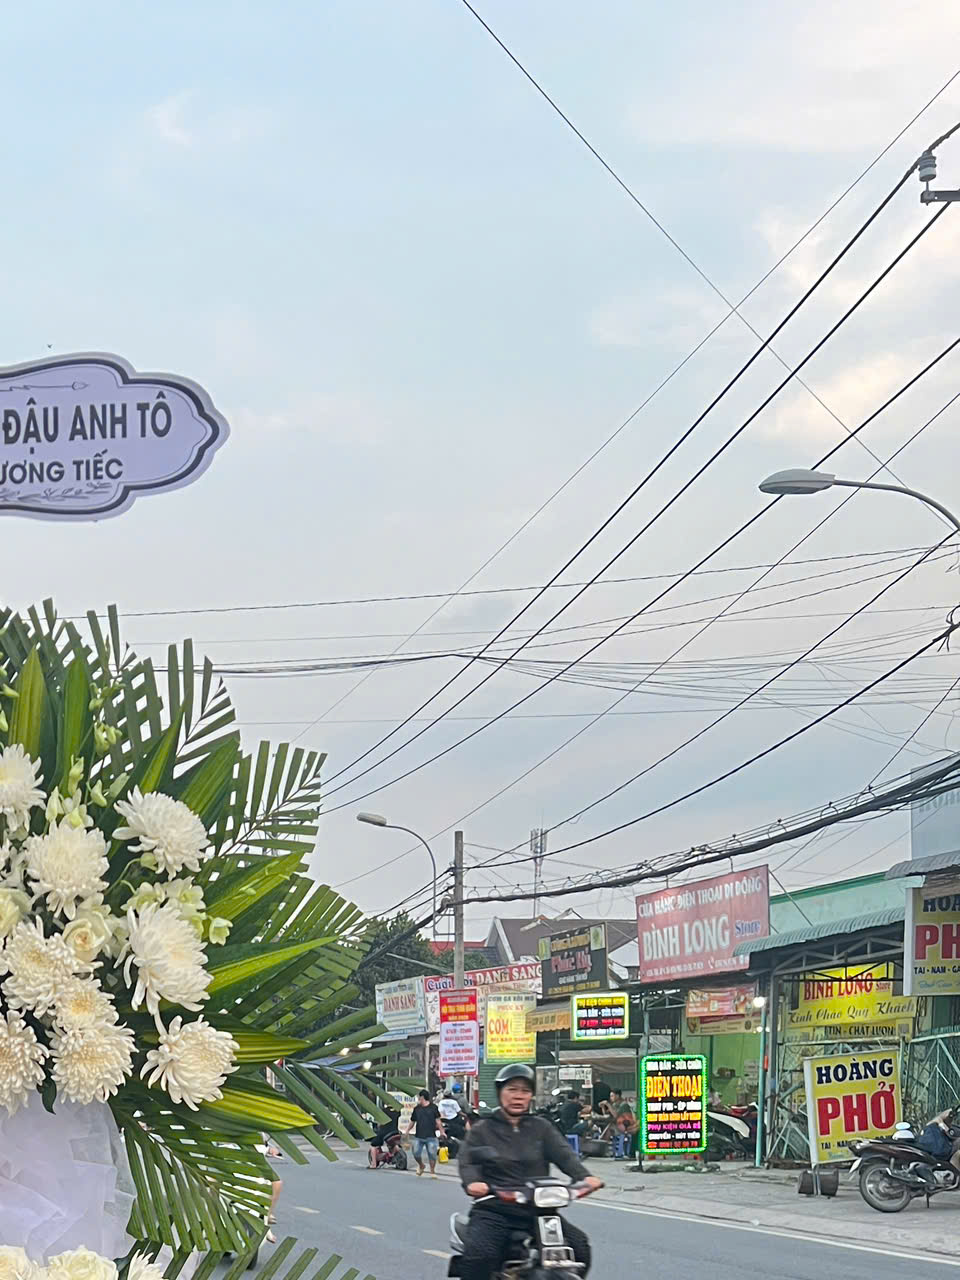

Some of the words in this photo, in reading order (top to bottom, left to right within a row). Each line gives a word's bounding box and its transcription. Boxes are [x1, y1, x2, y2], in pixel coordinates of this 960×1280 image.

[2, 397, 59, 455] ĐẬU
[69, 402, 128, 442] ANH
[137, 391, 172, 438] TÔ
[72, 448, 124, 481] TIẾC
[642, 922, 680, 961] BÌNH
[683, 914, 731, 956] LONG
[646, 1072, 670, 1101] ĐIỆN
[671, 1075, 703, 1100] THOẠI
[816, 1058, 894, 1085] HOÀNG
[817, 1081, 896, 1136] PHỞ
